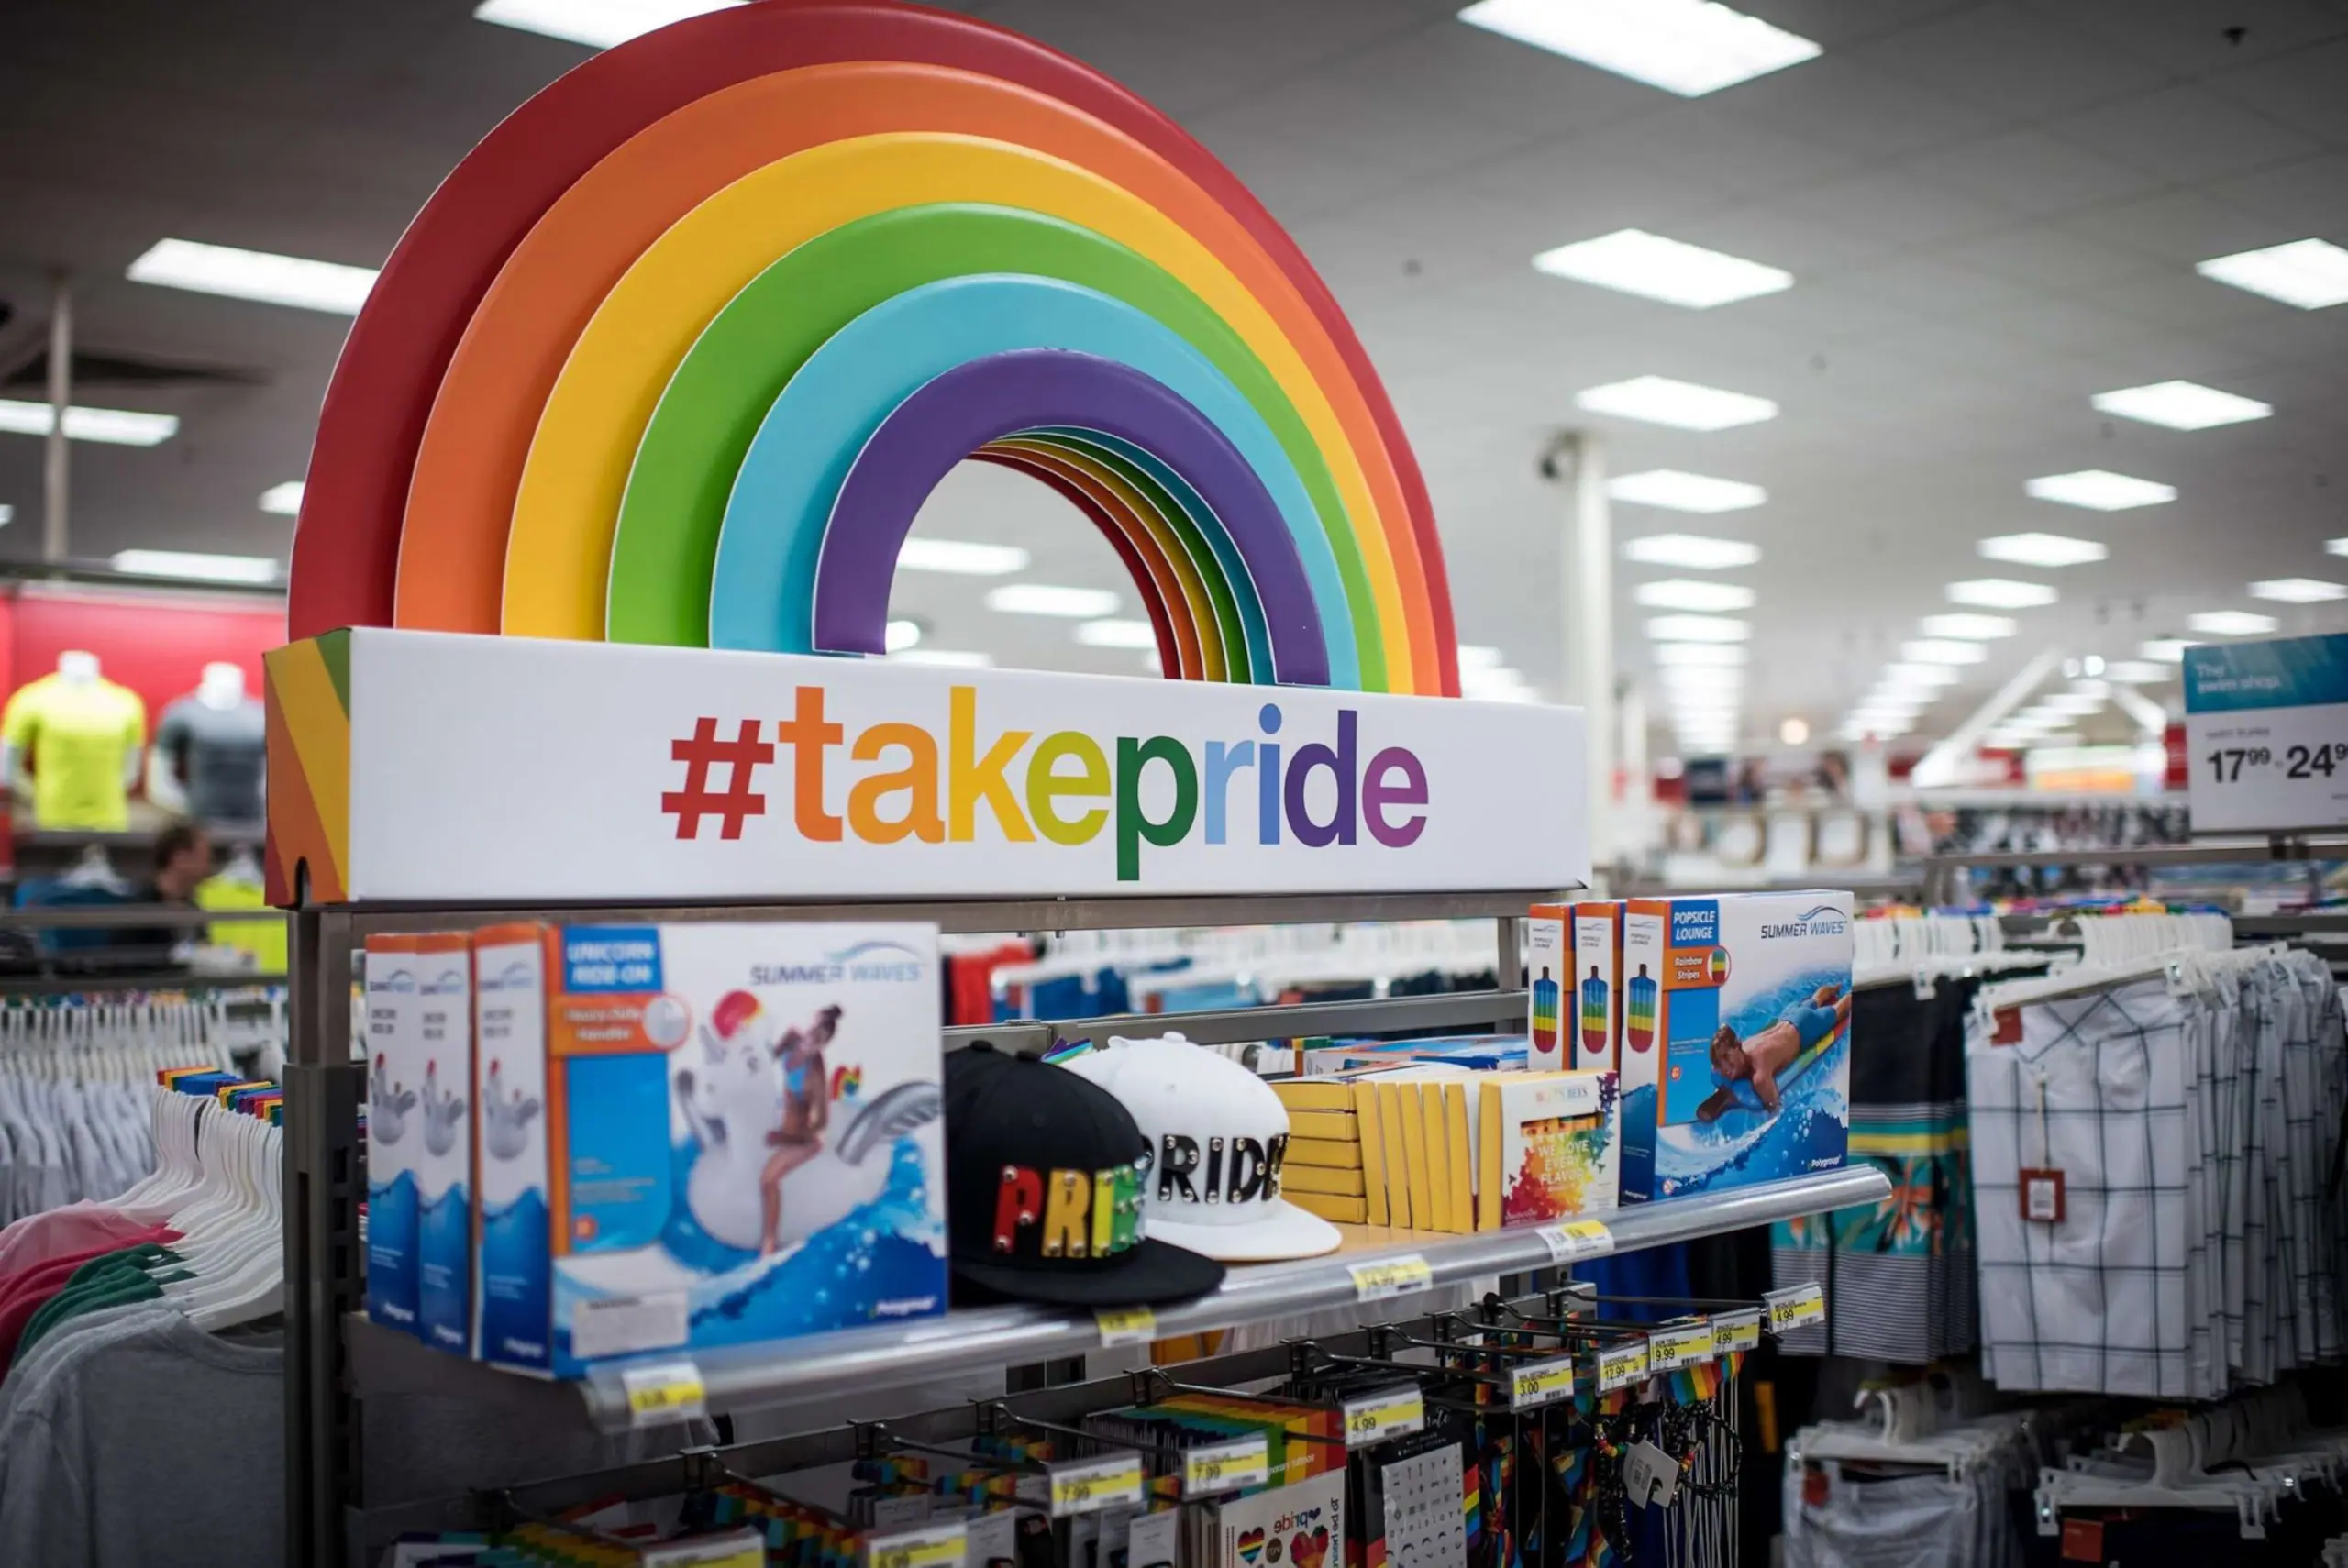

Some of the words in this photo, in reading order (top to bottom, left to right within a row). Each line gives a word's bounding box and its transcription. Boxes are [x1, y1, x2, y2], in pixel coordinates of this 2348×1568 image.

[661, 685, 1429, 881] #takepride
[1673, 910, 1716, 925] POPSICLE
[1675, 926, 1714, 941] LOUNGE
[1760, 922, 1808, 940] SUMMER
[1810, 920, 1844, 936] WAVES
[1675, 956, 1703, 966] Rainbow
[750, 966, 845, 986] SUMMER
[1678, 970, 1700, 980] Stripes
[1537, 1144, 1556, 1158] WE
[1561, 1138, 1589, 1154] OVE
[992, 1160, 1145, 1259] PRI
[1656, 1348, 1674, 1362] 9.99
[1519, 1381, 1539, 1397] 3.00
[1353, 1417, 1376, 1432] 4.99
